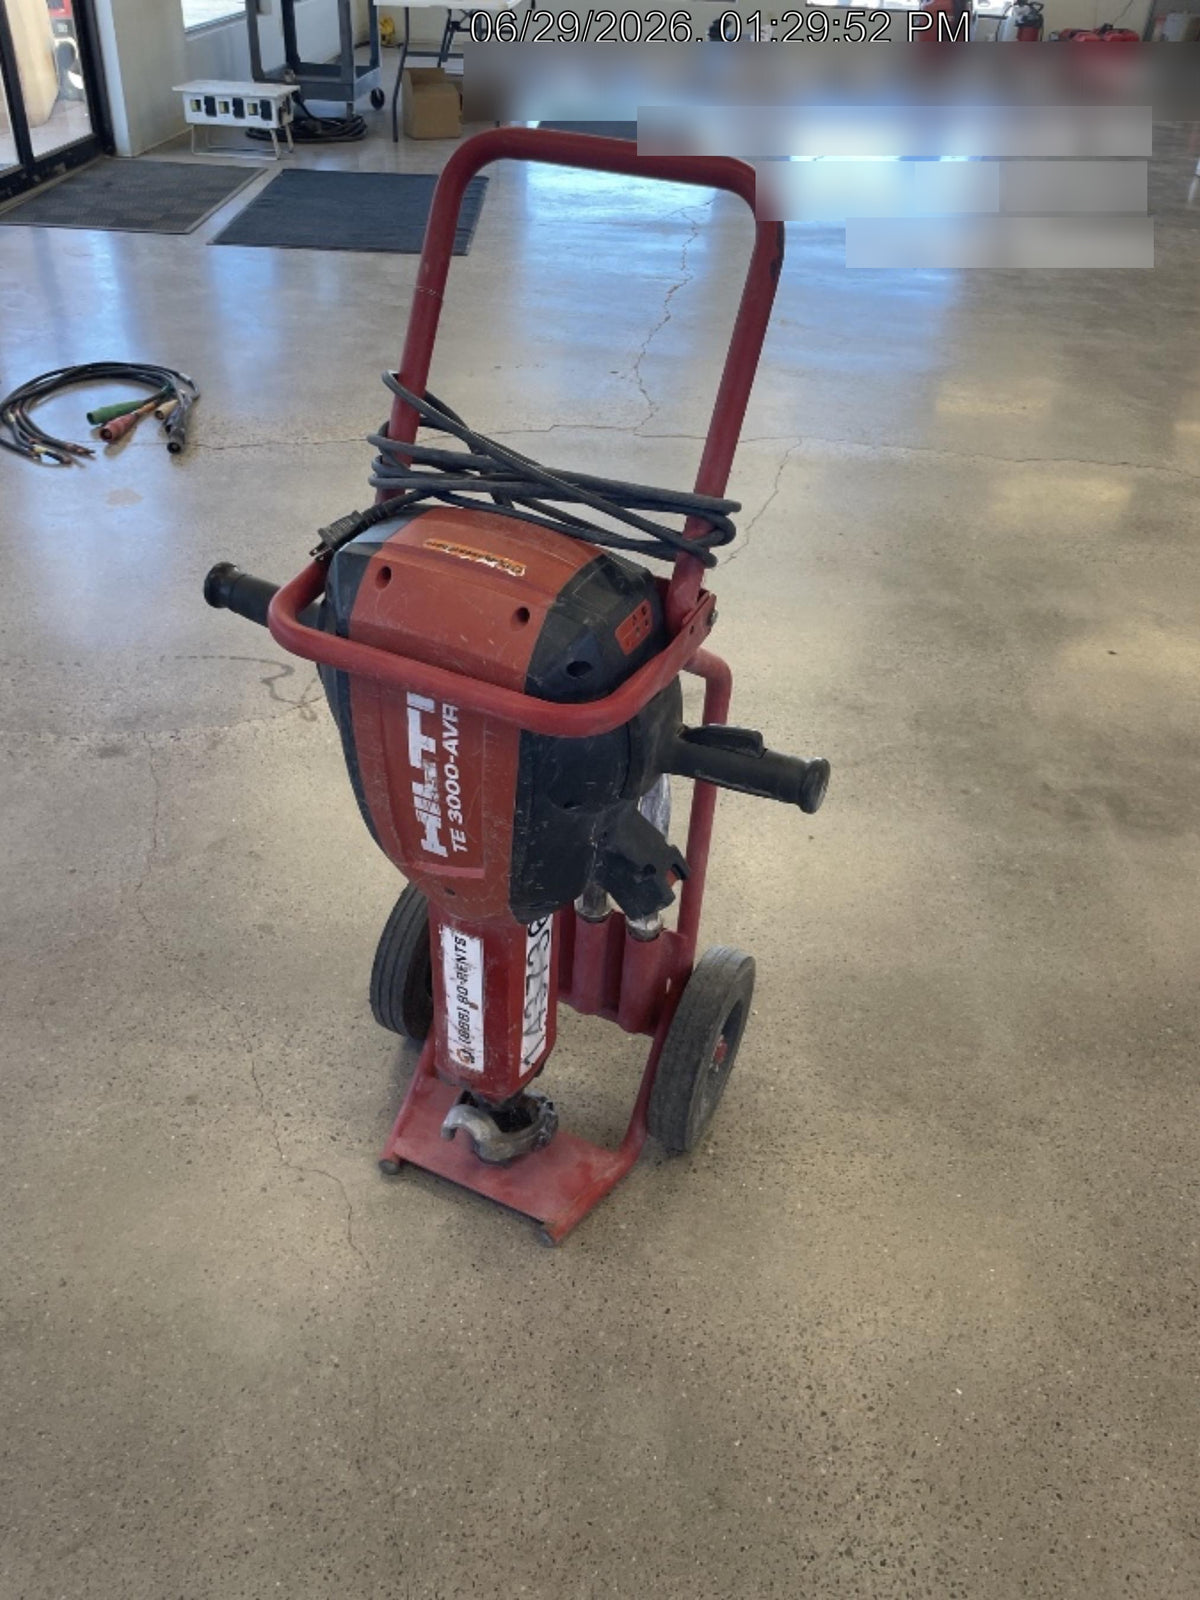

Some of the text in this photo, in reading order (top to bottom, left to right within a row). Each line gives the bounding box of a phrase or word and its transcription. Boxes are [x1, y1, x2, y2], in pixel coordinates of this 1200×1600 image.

[406, 691, 448, 858] HILTI
[442, 703, 468, 852] TE 3000-AVR
